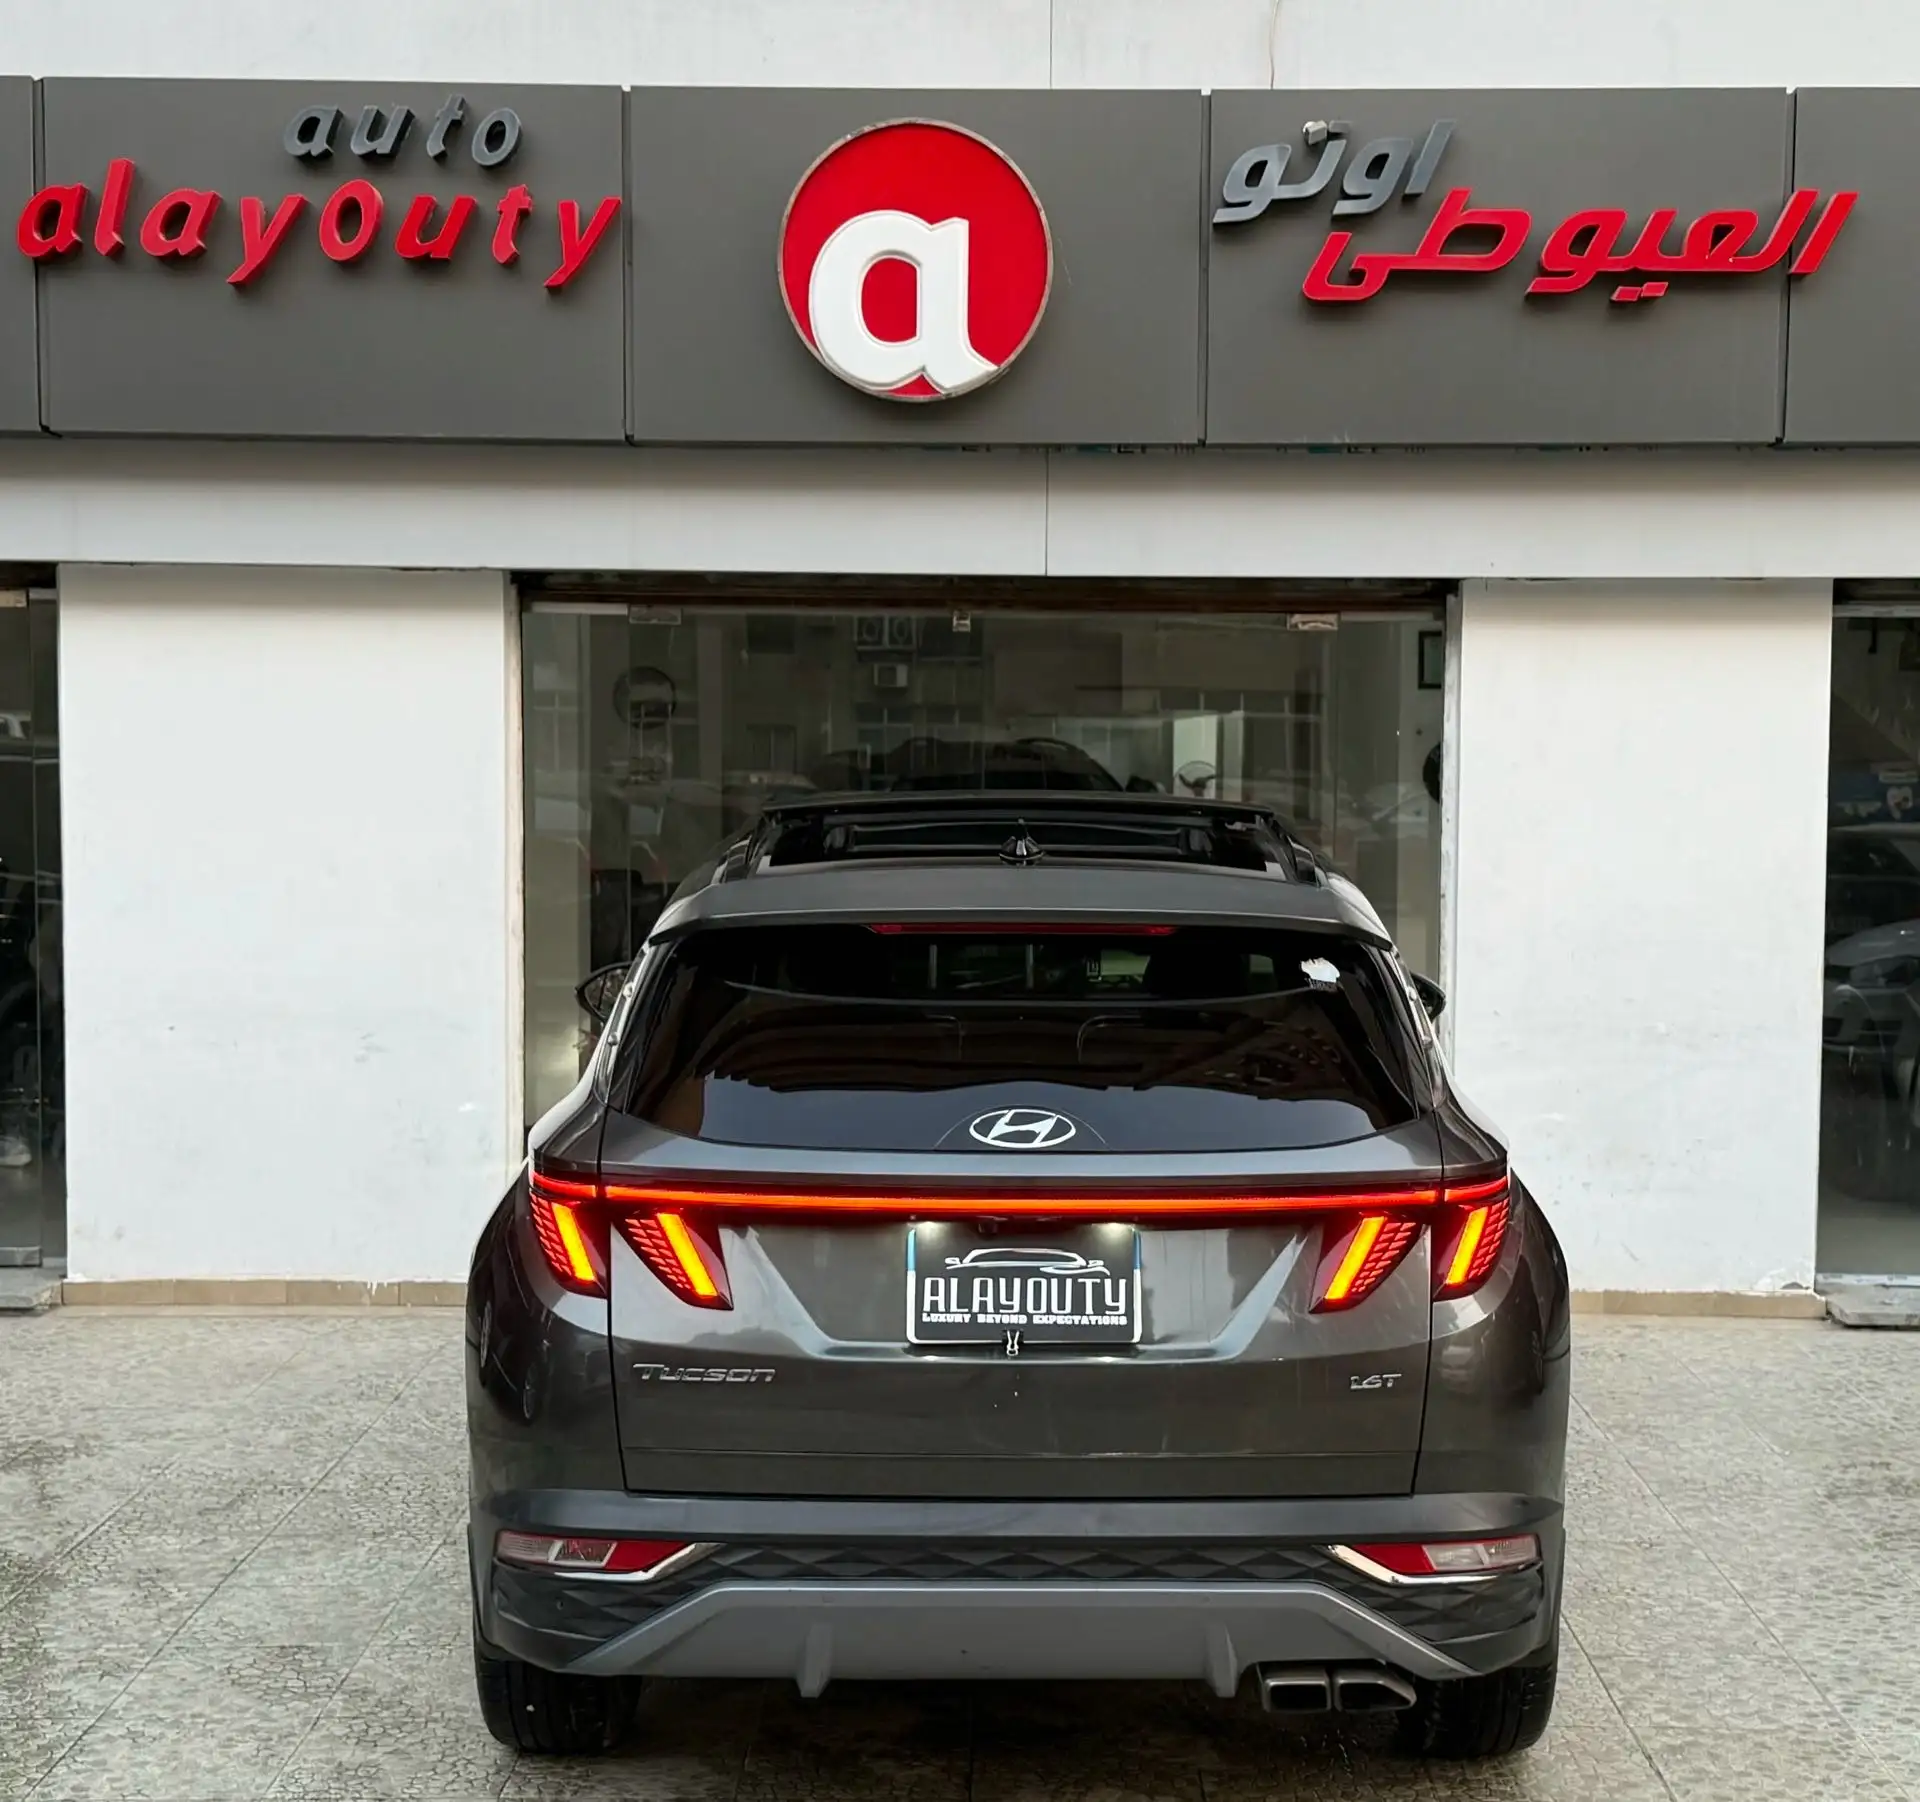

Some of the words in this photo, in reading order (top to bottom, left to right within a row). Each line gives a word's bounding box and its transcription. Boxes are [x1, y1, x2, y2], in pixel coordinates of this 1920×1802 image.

[284, 94, 523, 168] auto
[922, 1276, 1128, 1315] ALAYOUTY
[921, 1312, 972, 1324] LUXURY
[976, 1313, 1028, 1325] BEYOND
[1032, 1314, 1129, 1326] EXPECTATIONS
